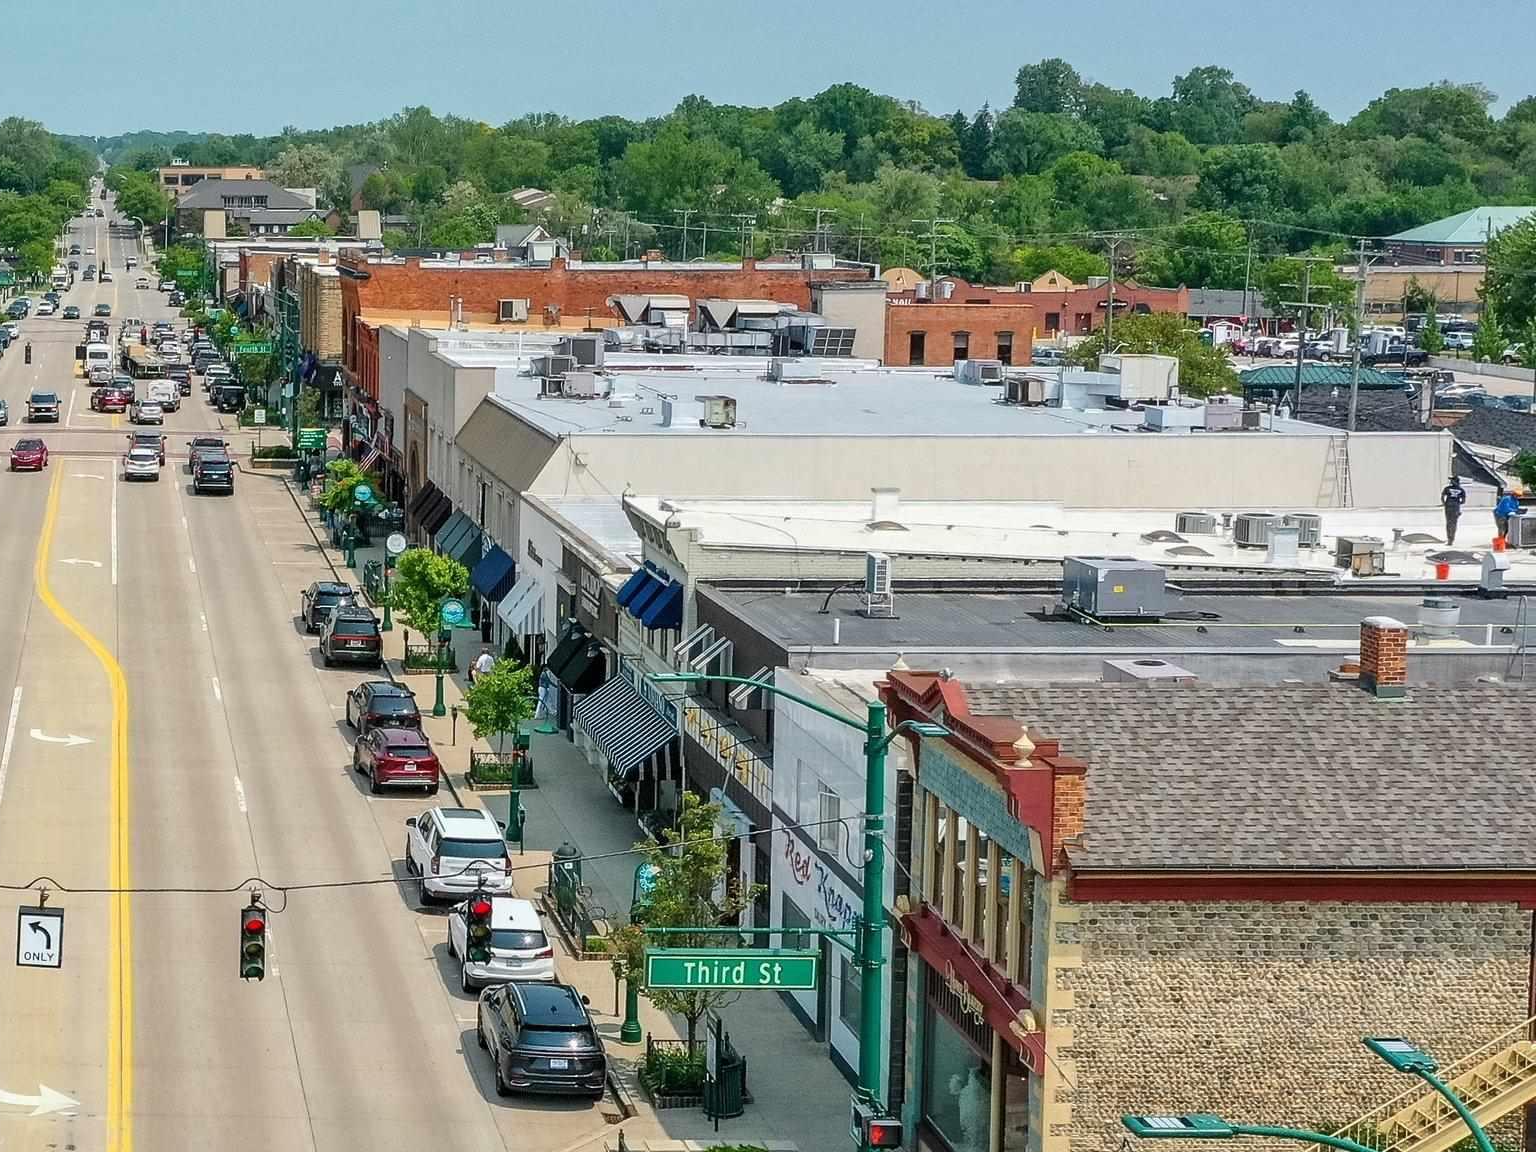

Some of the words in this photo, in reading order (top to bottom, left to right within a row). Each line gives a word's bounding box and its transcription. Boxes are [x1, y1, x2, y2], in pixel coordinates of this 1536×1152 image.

[782, 829, 811, 886] Red
[24, 951, 54, 962] ONLY
[684, 961, 745, 984] Third
[759, 962, 782, 984] St
